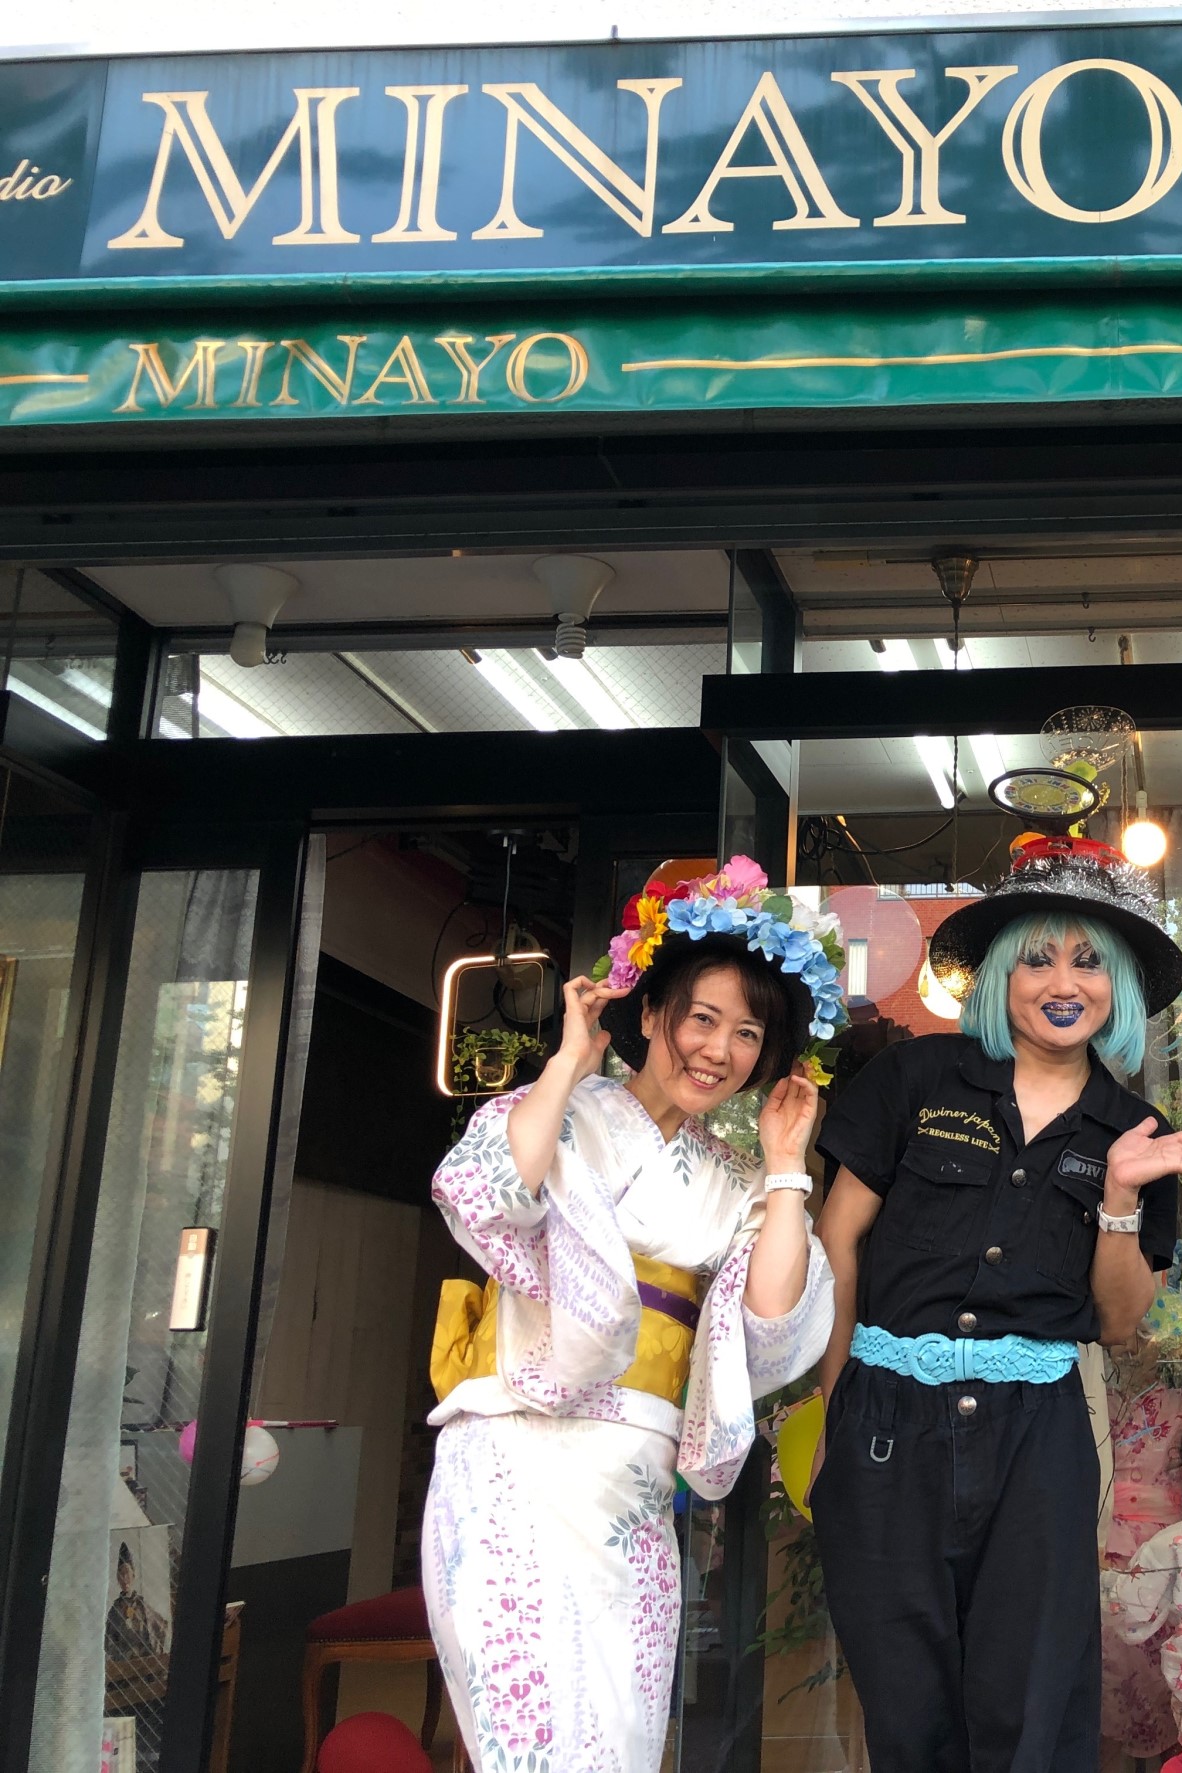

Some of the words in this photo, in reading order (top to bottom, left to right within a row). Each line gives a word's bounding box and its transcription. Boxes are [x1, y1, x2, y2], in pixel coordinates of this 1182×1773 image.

[112, 332, 589, 413] MINAYO
[929, 1127, 970, 1143] RECKLESS
[971, 1137, 989, 1149] LIFE
